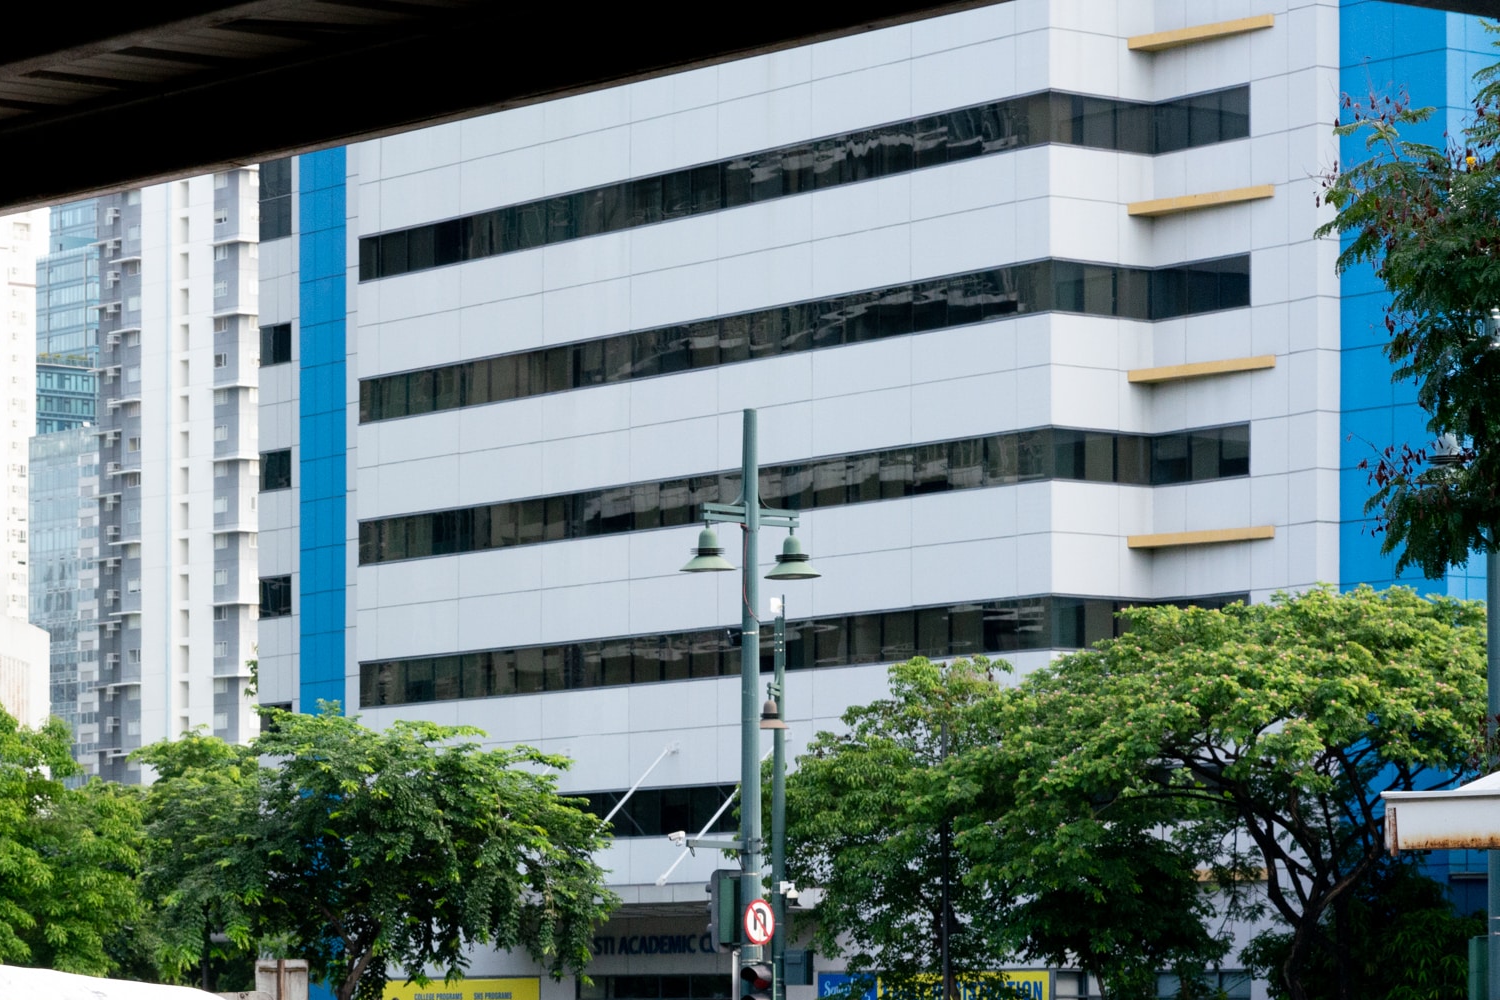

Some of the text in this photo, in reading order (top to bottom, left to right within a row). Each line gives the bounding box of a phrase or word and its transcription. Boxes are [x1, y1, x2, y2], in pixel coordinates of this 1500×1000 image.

[618, 934, 696, 954] ACADEMIC
[414, 992, 463, 1000] COLLEGE PROGRAMS
[485, 991, 512, 1000] PROGRAMS
